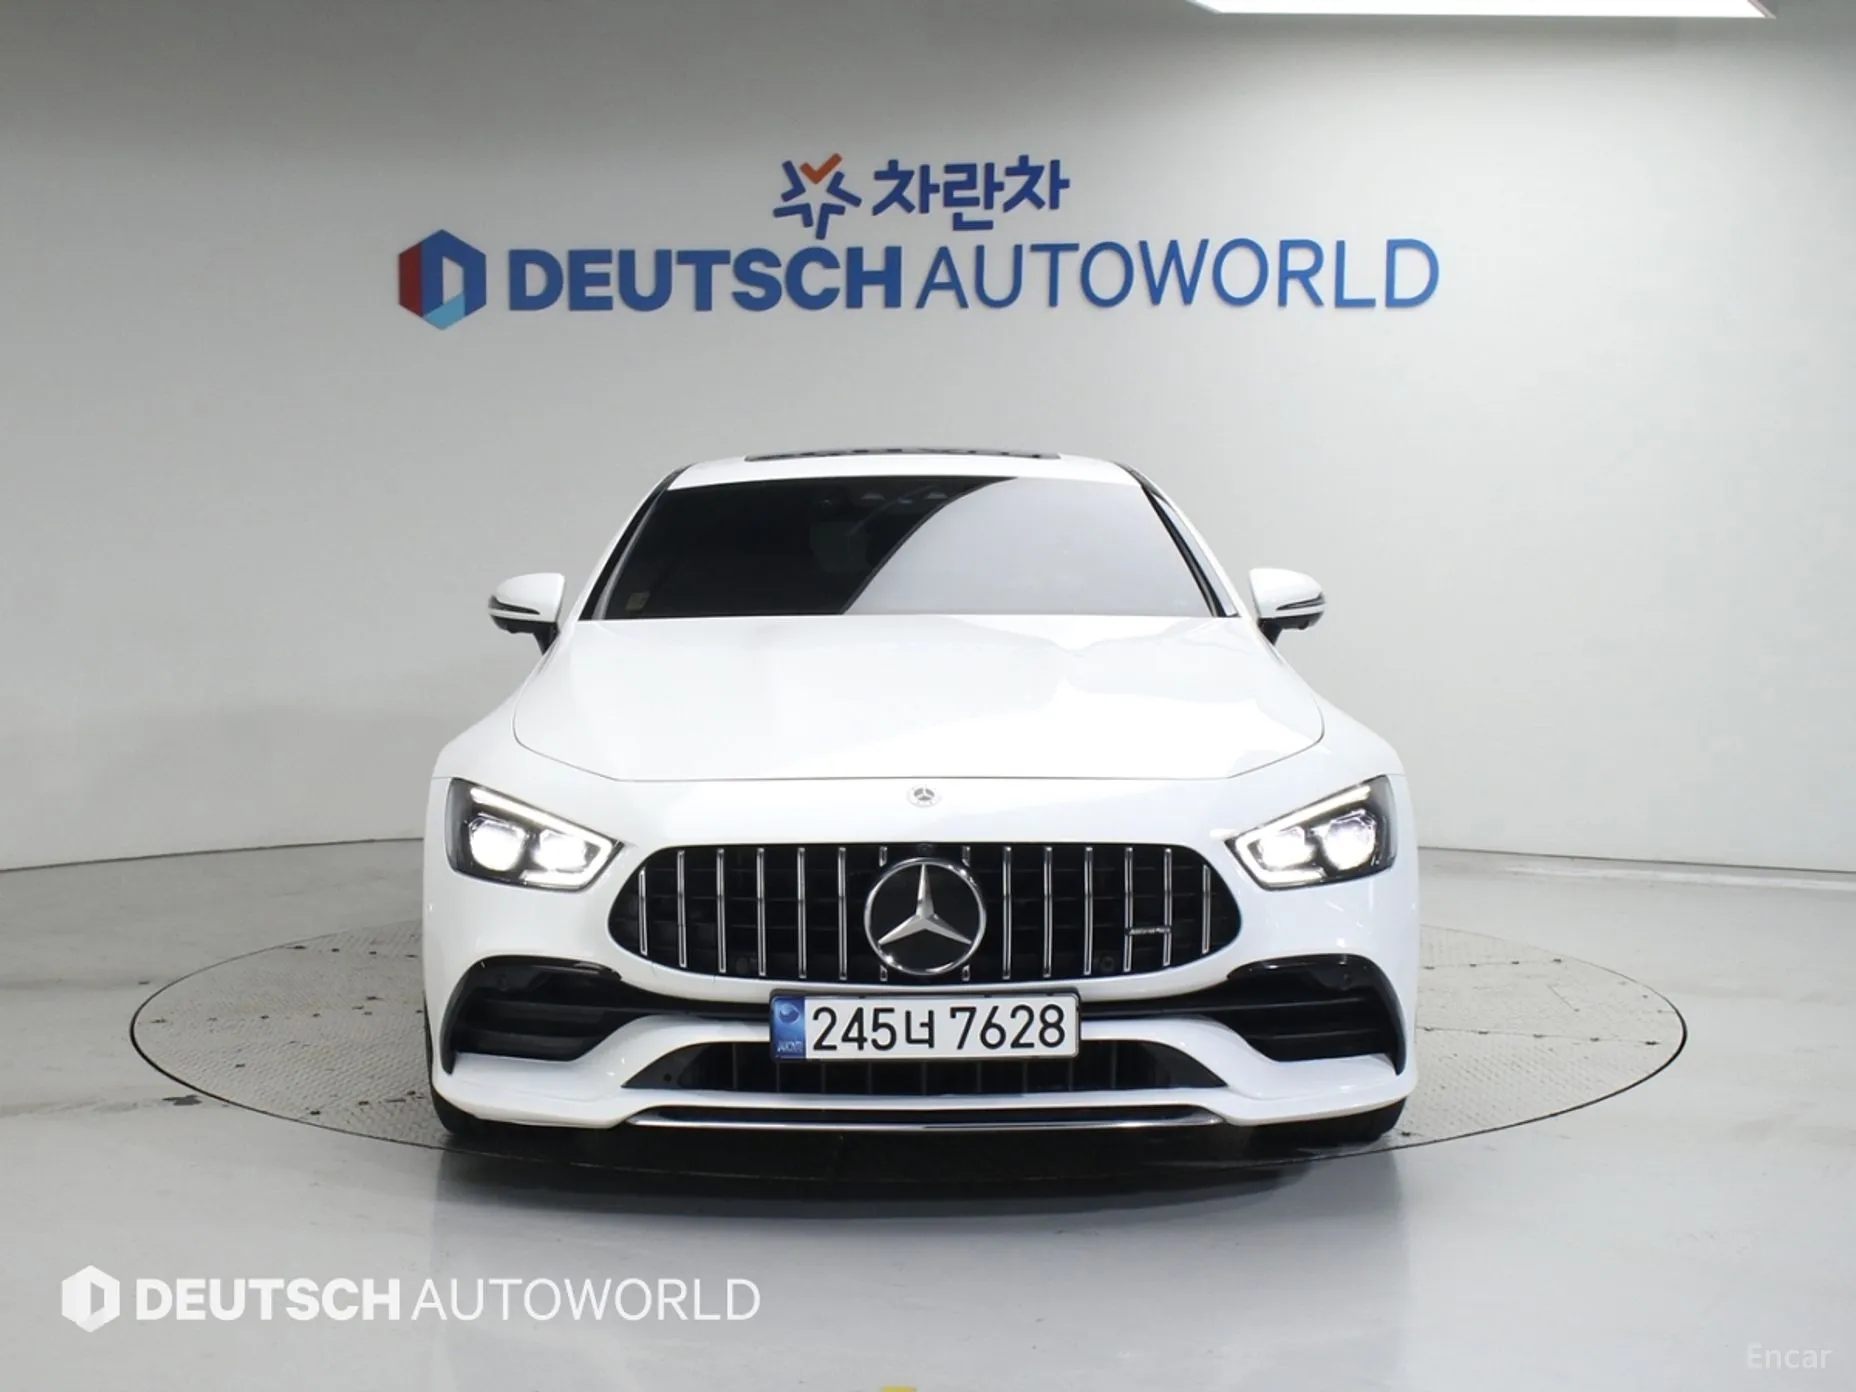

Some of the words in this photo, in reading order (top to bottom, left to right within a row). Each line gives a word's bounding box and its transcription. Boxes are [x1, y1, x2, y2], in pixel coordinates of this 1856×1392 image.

[873, 155, 1071, 231] 차란차
[812, 1006, 935, 1051] 245너
[949, 1004, 1065, 1050] 7628
